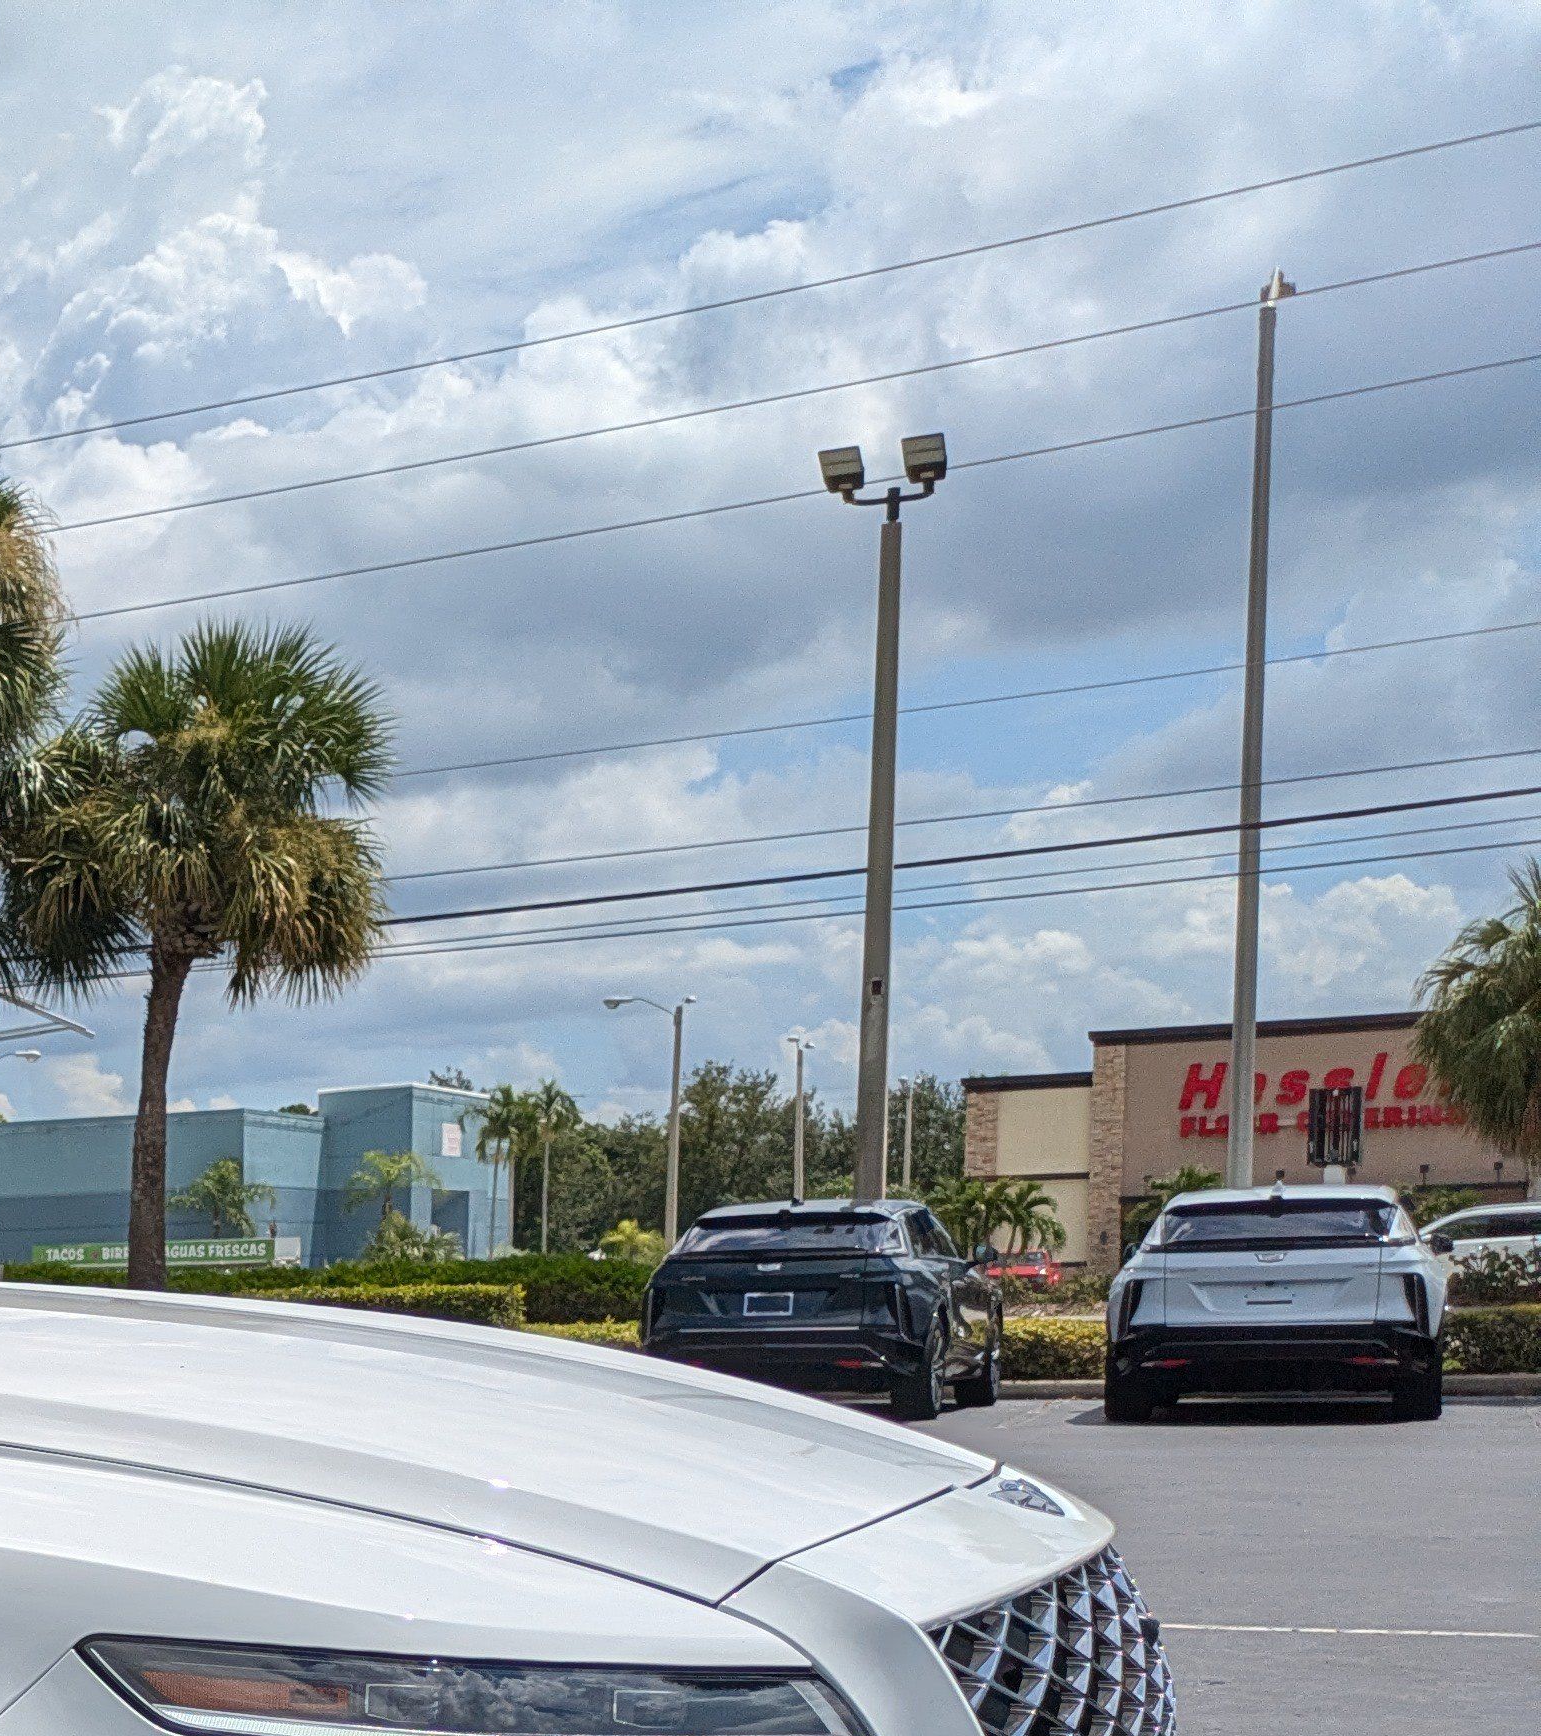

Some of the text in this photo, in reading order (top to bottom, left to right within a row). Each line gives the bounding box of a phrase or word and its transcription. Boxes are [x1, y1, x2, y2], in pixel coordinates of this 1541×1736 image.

[1179, 1051, 1452, 1110] Hssle
[1179, 1104, 1468, 1138] FLOR CERING
[45, 1247, 85, 1261] TACOS
[165, 1244, 205, 1258] AGUAS
[208, 1242, 267, 1257] FRESCAS
